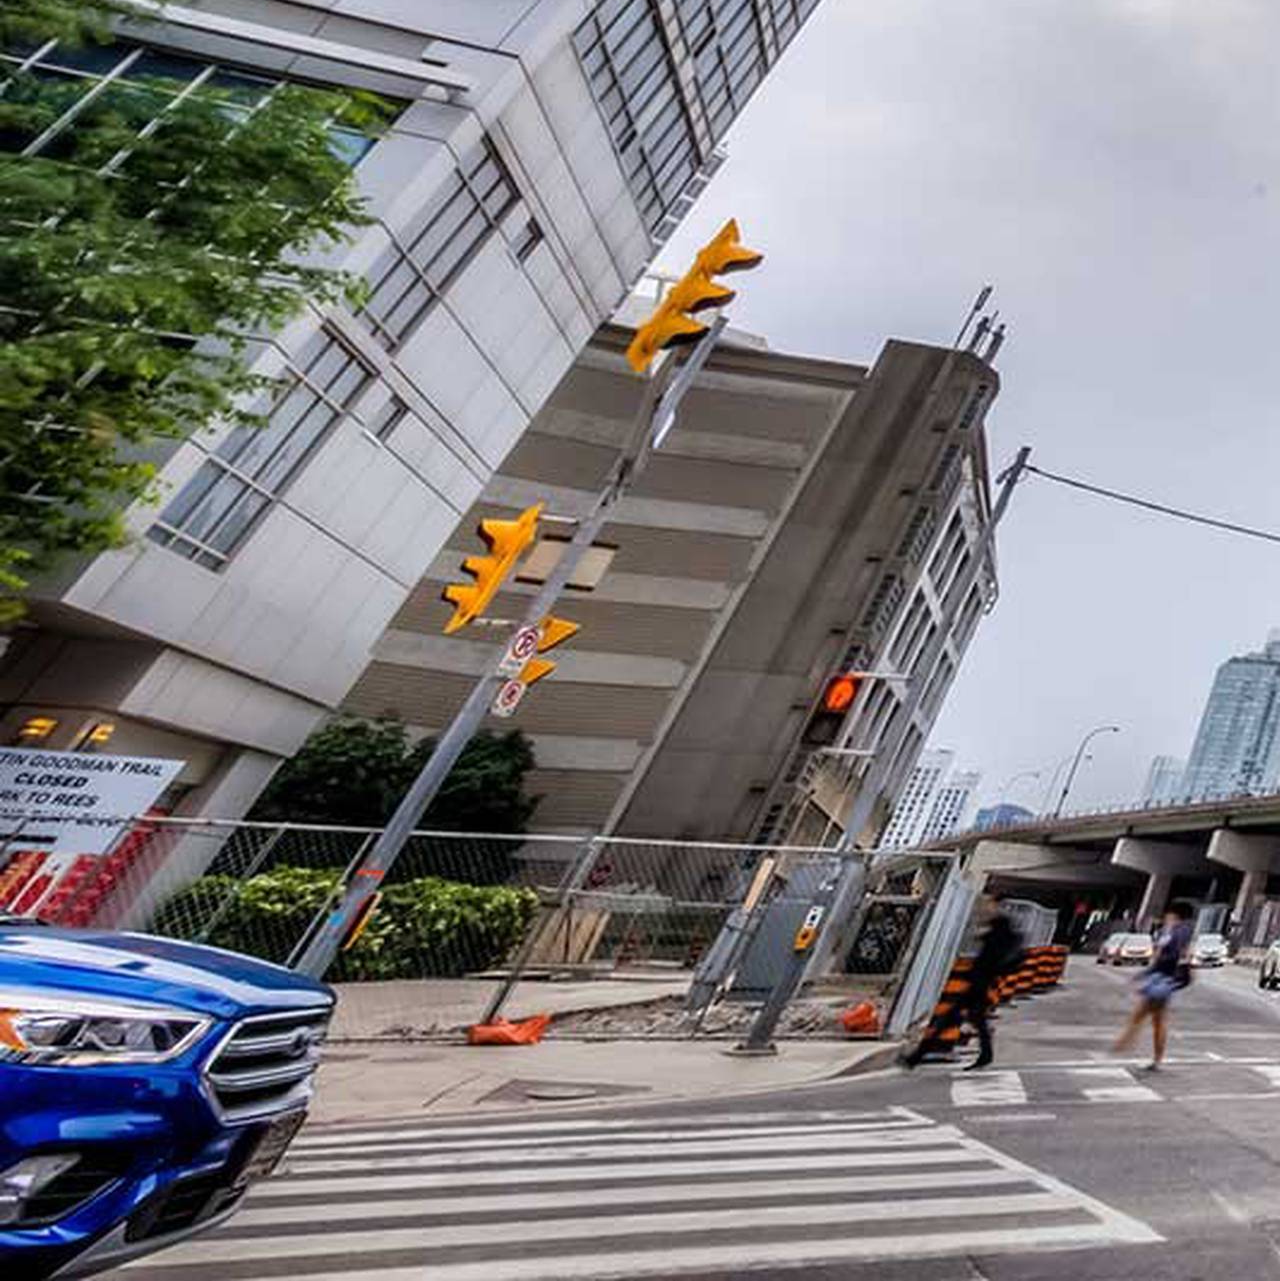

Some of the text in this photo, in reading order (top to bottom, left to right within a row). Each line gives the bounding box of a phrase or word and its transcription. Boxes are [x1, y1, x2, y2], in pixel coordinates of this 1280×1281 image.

[30, 754, 116, 772] GOODMAN
[119, 761, 163, 777] TRAIL
[14, 772, 89, 789] CLOSED
[26, 791, 51, 805] TO
[51, 792, 100, 808] REES
